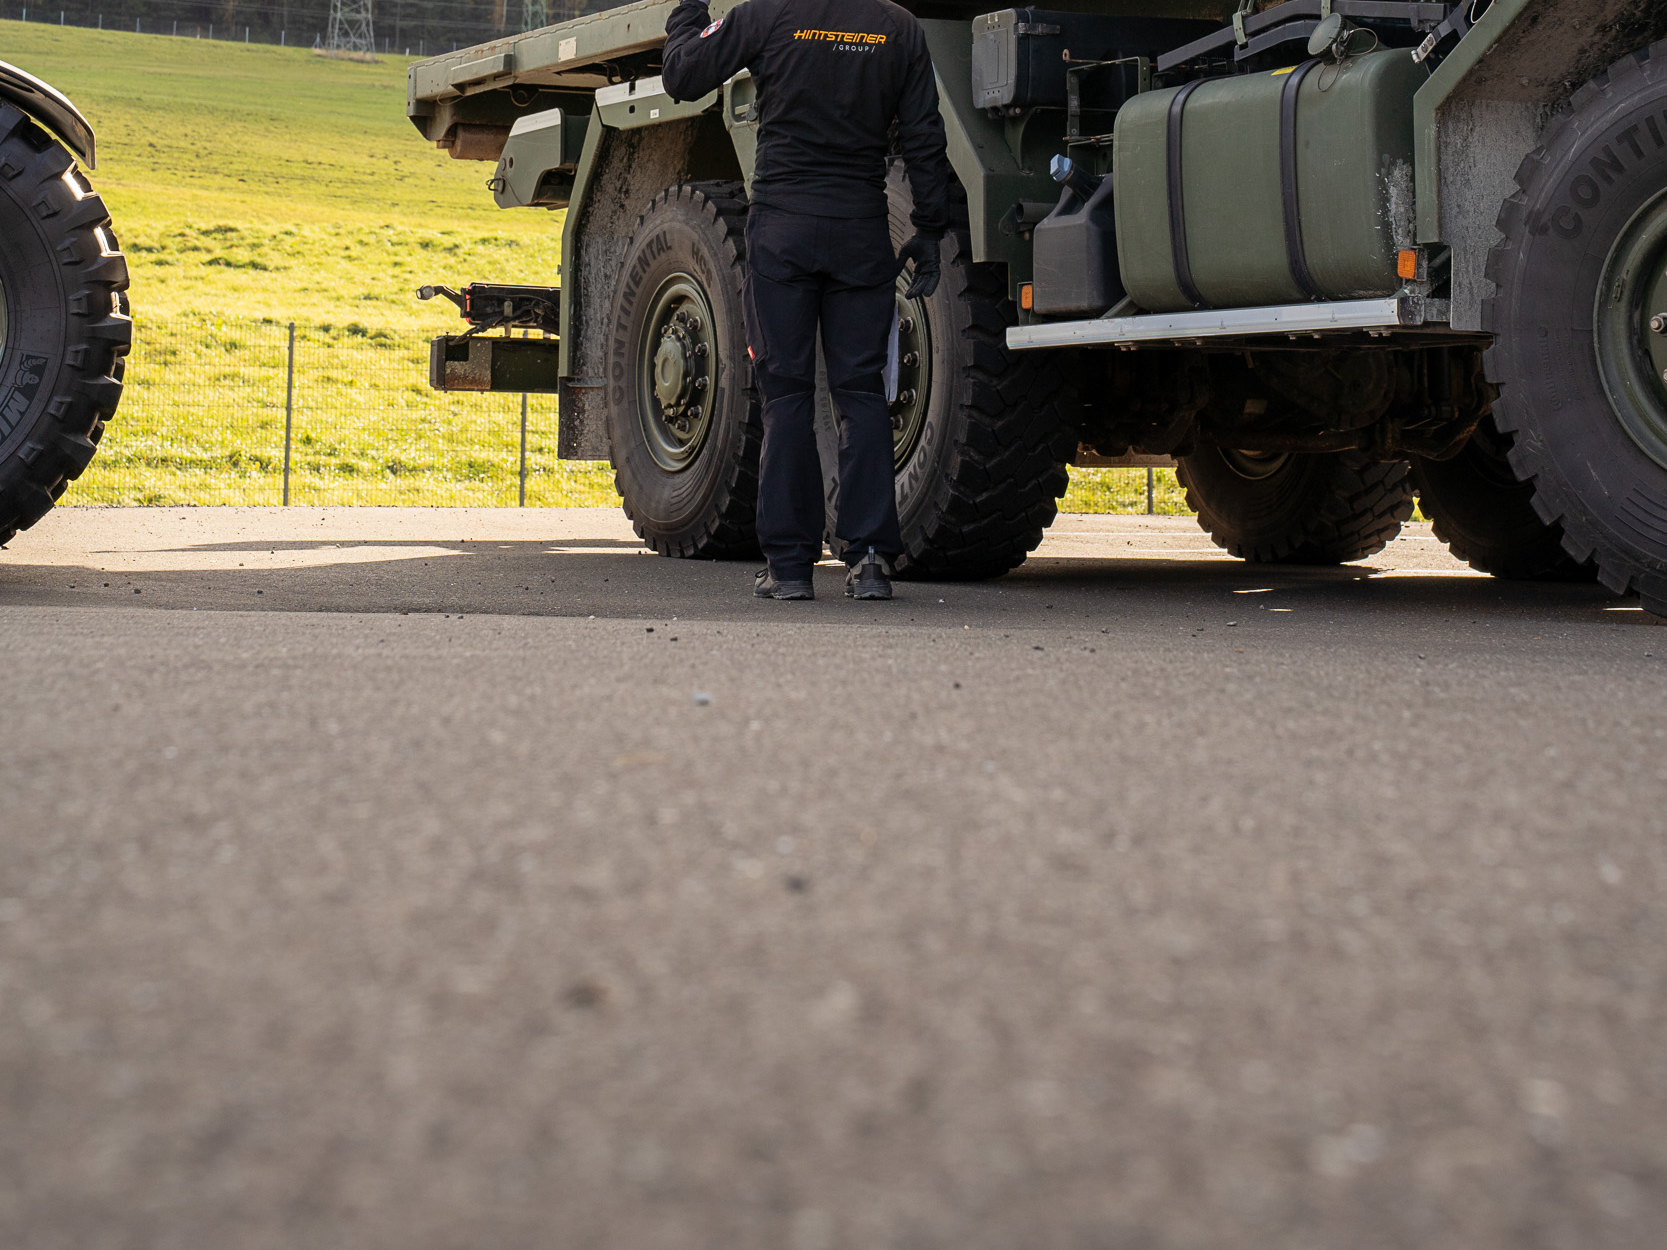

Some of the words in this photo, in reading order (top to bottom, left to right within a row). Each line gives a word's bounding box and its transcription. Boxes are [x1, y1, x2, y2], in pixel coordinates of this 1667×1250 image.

[793, 29, 887, 45] HINTSTEINER
[1551, 108, 1667, 240] CONTI
[611, 230, 672, 406] CONTINENTAL
[898, 421, 935, 509] CONT
